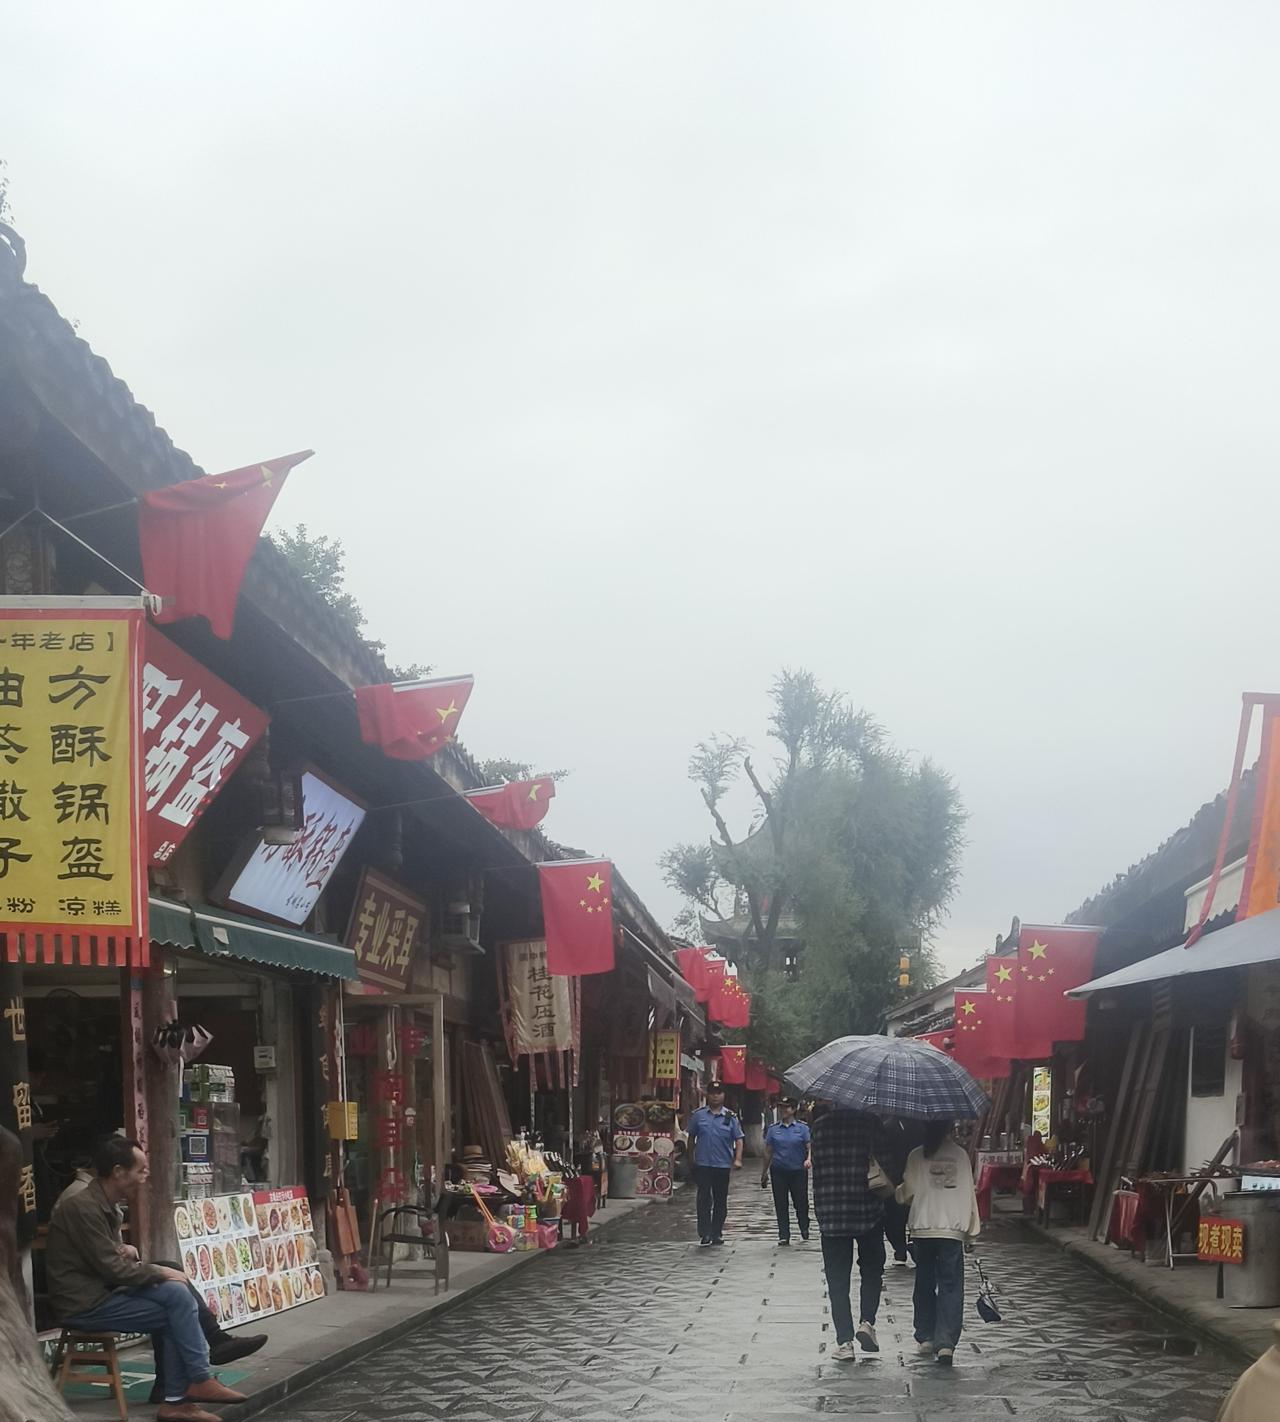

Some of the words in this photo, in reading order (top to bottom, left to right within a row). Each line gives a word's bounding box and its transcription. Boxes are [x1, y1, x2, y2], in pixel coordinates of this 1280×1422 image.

[48, 665, 114, 882] 方酥锅盔
[58, 896, 122, 916] 凉糕
[354, 892, 418, 976] 专业采耳
[1198, 1223, 1243, 1258] 现煮现卖
